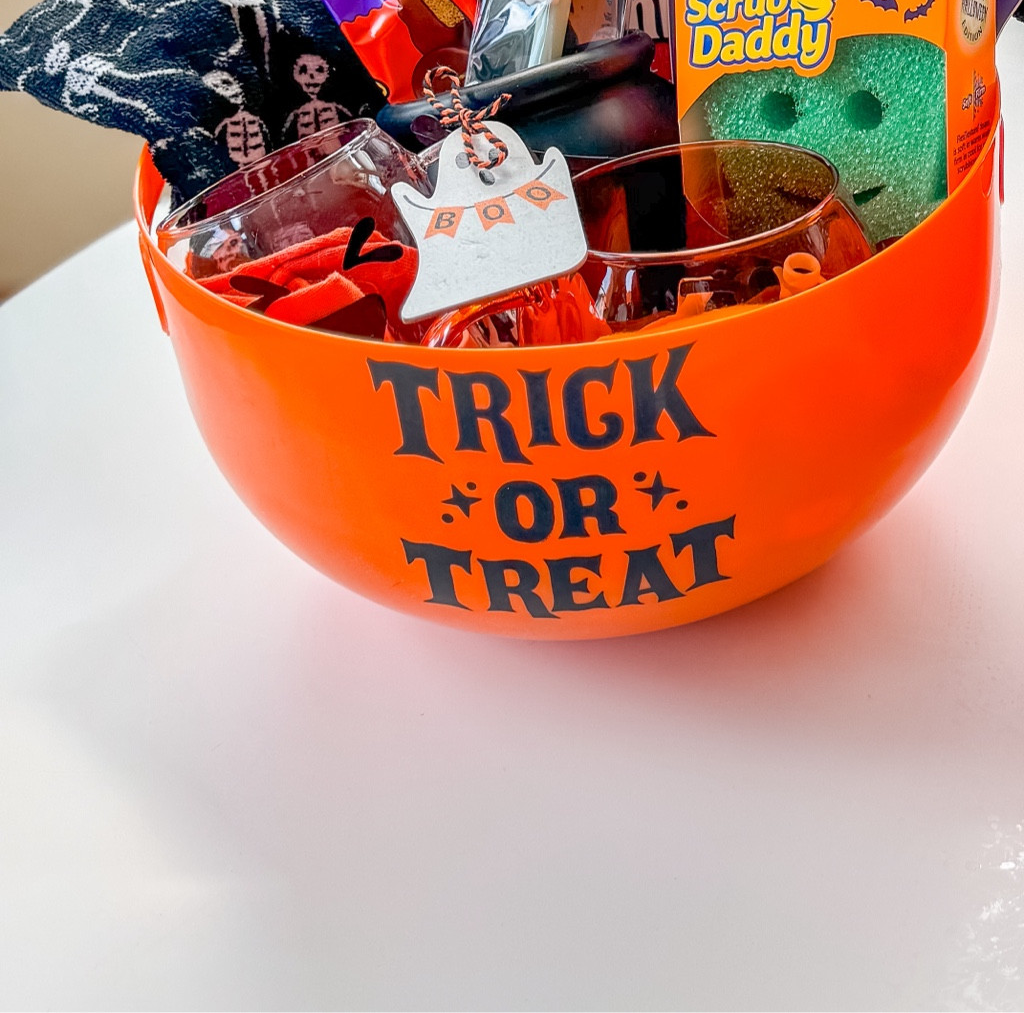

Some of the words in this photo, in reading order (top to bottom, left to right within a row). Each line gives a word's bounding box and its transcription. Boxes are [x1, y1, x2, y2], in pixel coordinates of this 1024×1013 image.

[691, 11, 830, 68] Daddy
[961, 19, 983, 41] EDITION
[434, 185, 553, 232] BOO
[366, 341, 717, 465] TRICK
[494, 474, 627, 544] OR
[400, 514, 736, 619] TREAT
